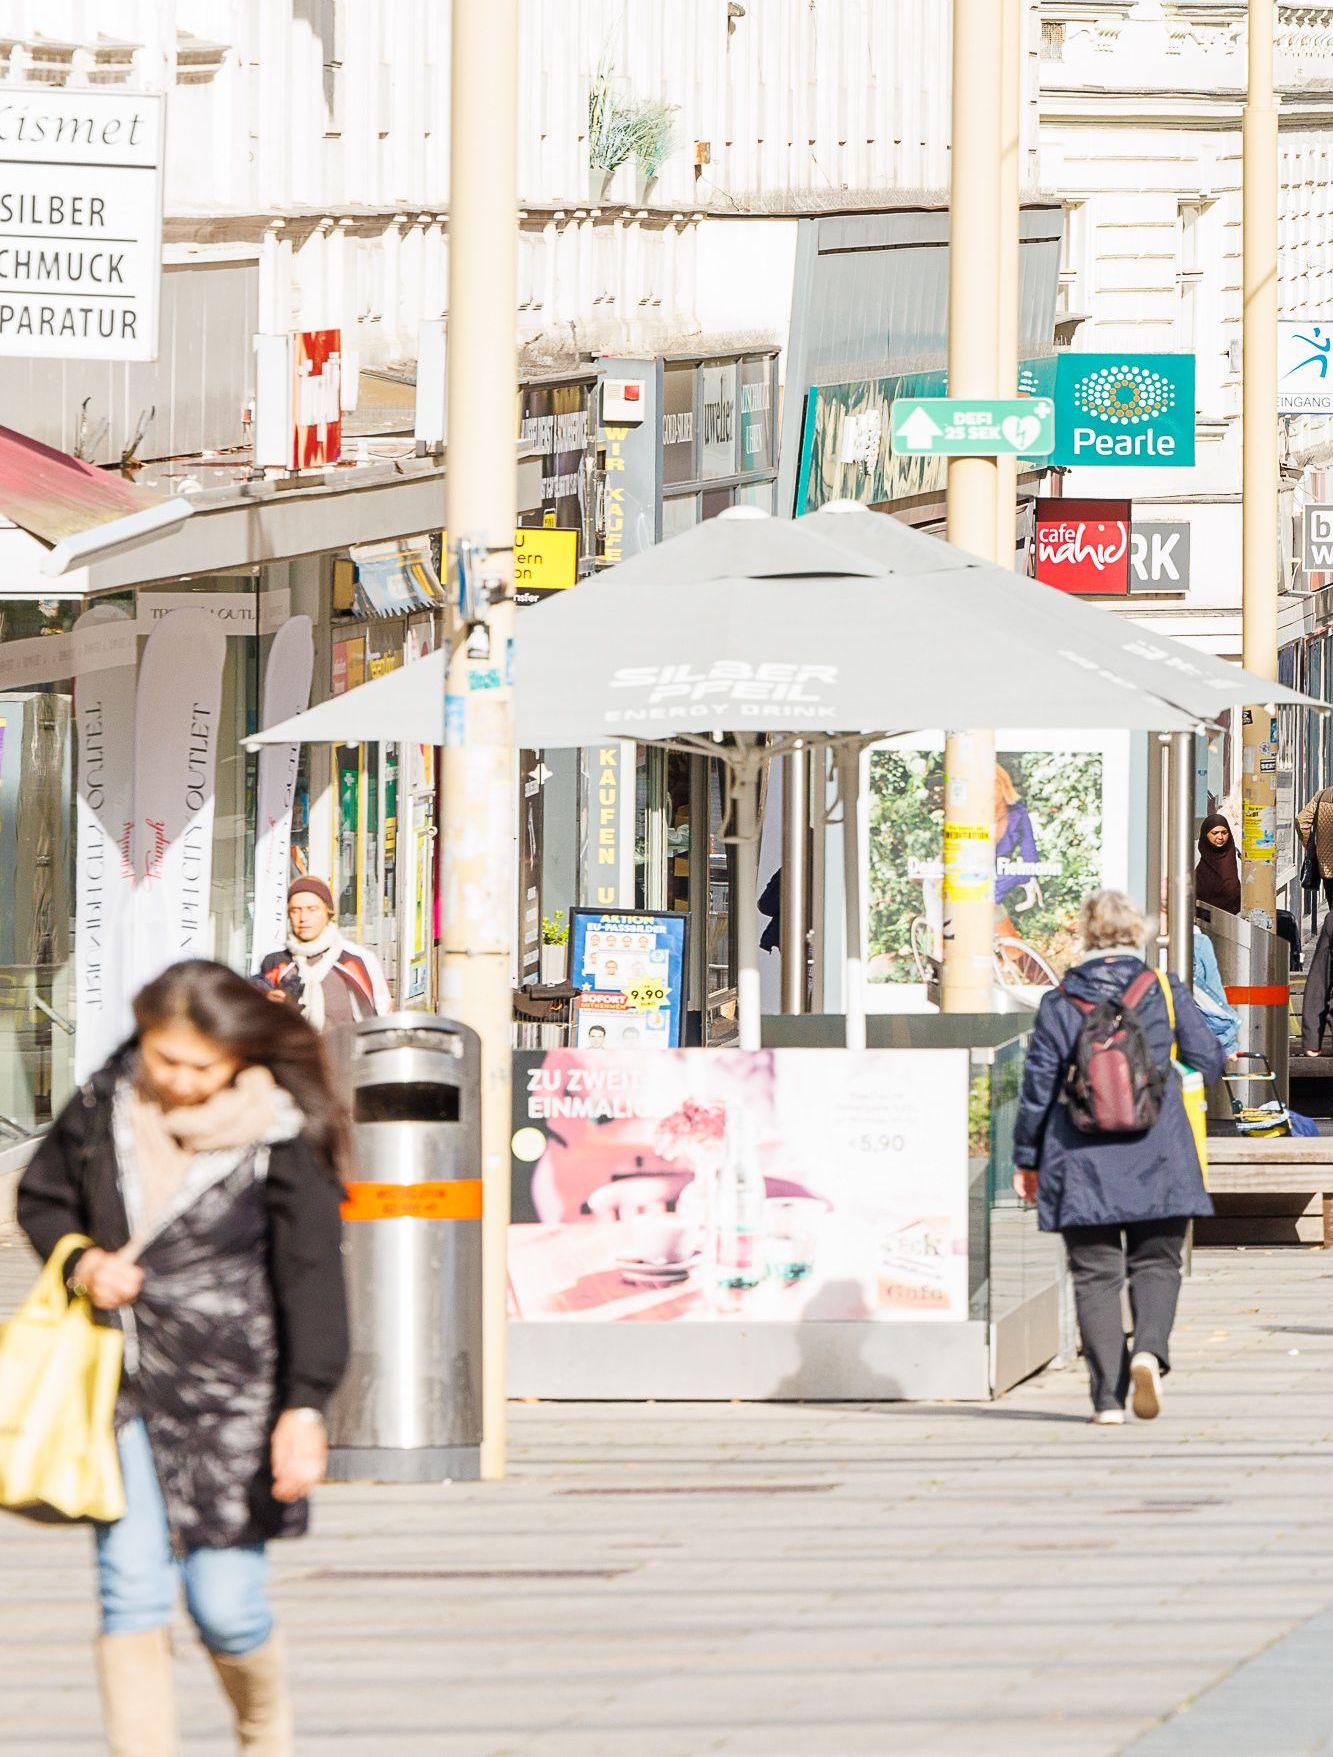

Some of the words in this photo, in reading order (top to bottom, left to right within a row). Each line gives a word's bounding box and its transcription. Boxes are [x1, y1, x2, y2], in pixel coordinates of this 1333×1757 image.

[0, 104, 144, 146] ismet
[0, 250, 124, 283] CHMUCK
[0, 304, 137, 339] PARATUR
[953, 411, 993, 428] DEFI
[1073, 428, 1176, 456] Pearle
[604, 488, 625, 562] KAUFE
[1039, 525, 1076, 543] cafe
[1130, 533, 1181, 581] RK
[609, 660, 838, 688] SILBER
[648, 679, 820, 704] PFEIL
[604, 703, 730, 722] ENERGY
[740, 703, 836, 718] DRINK
[600, 914, 656, 925] AKTION
[581, 993, 627, 1004] SOFORT
[527, 1068, 562, 1092] ZU
